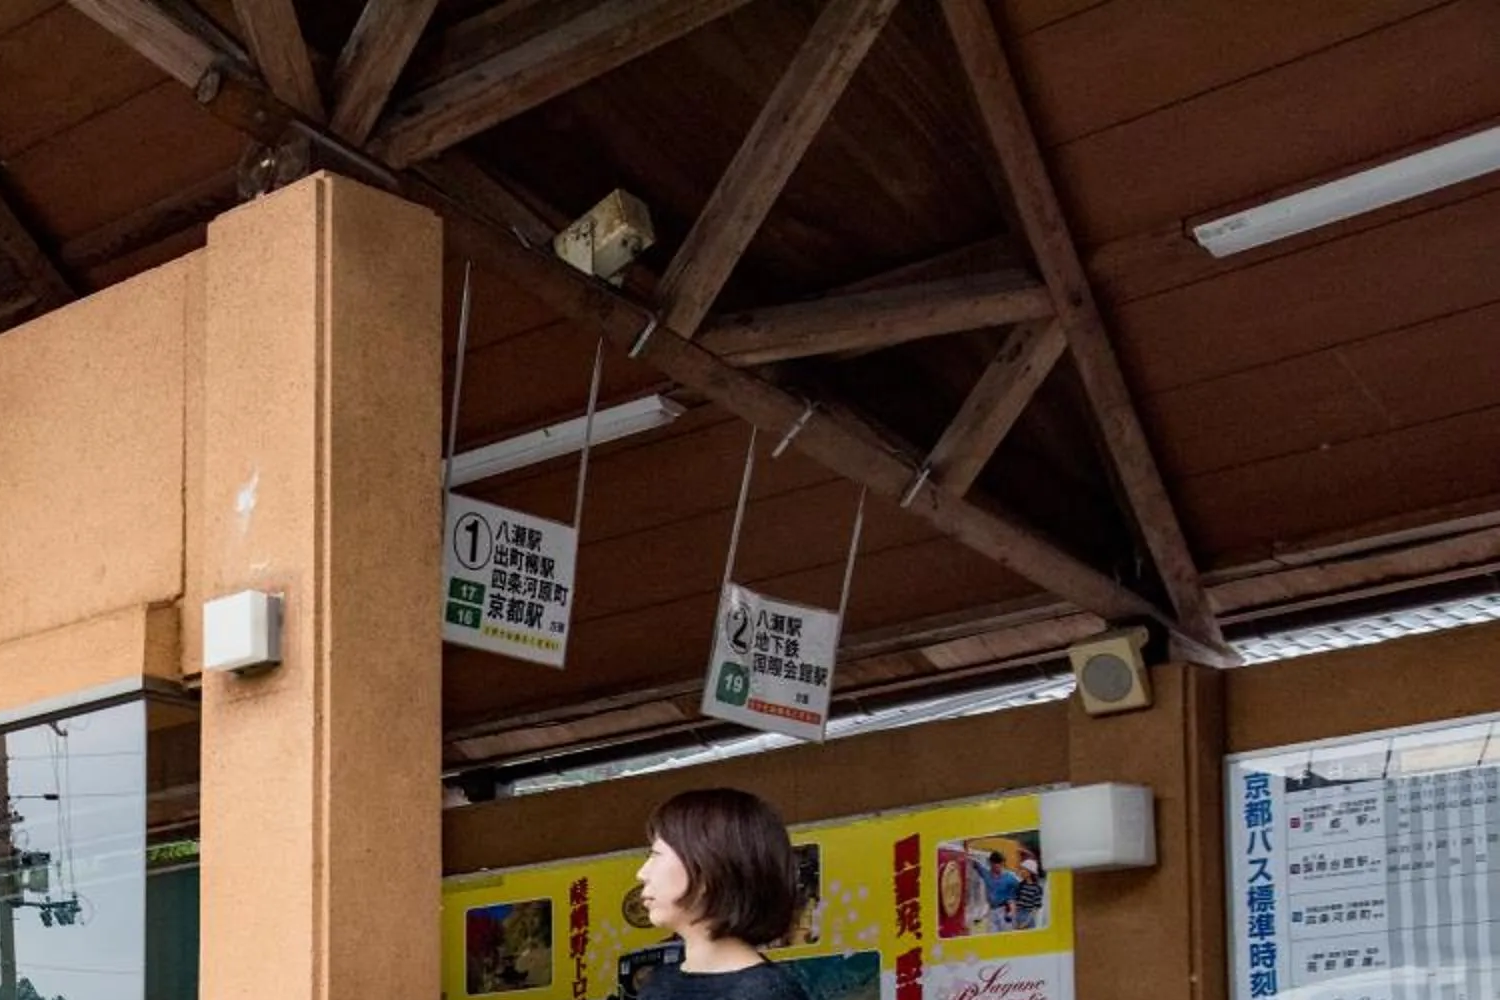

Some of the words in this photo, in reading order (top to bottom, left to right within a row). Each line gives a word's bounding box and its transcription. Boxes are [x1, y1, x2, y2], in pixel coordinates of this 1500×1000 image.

[495, 520, 543, 552] 八瀬駅
[493, 544, 556, 579] 出町柳駅
[461, 583, 478, 600] 17
[491, 569, 569, 607] 四条河原町
[487, 593, 545, 629] 京都駅
[756, 609, 802, 638] 八瀬駅
[754, 631, 800, 659] 地下鉄
[724, 672, 743, 692] 19
[753, 652, 828, 687] 国際会館駅
